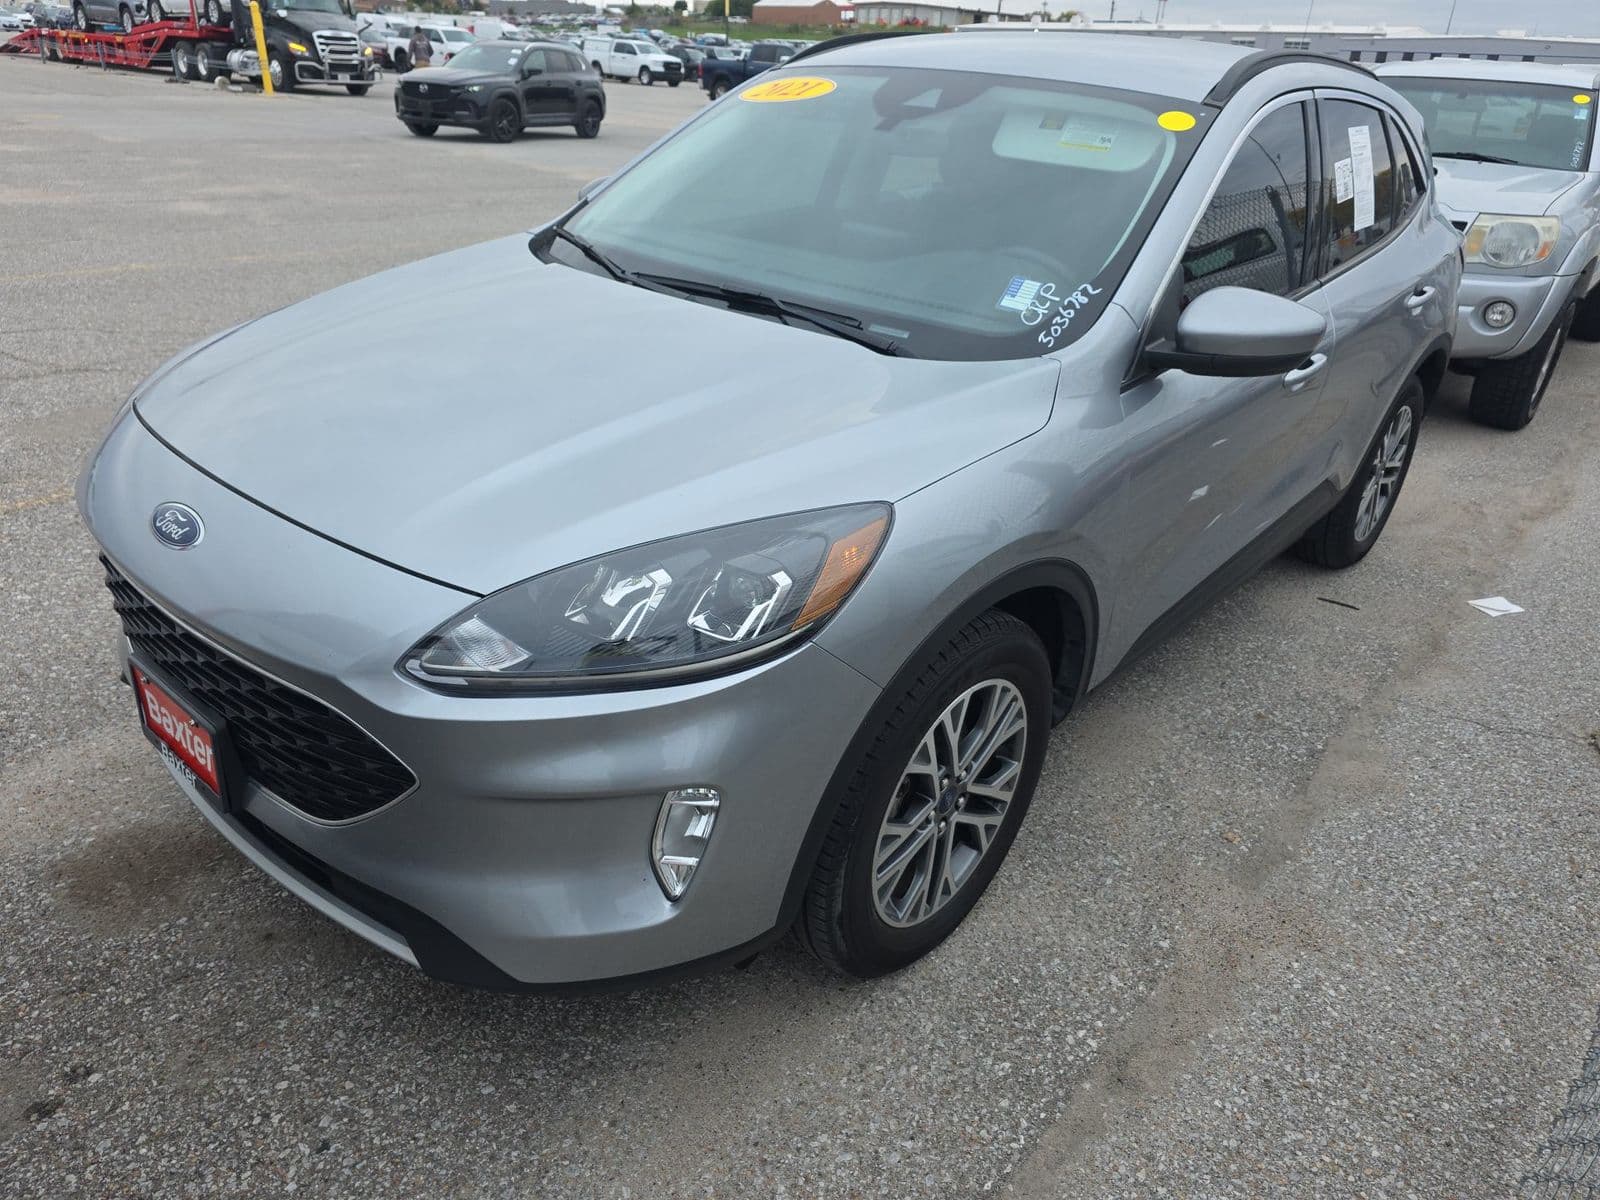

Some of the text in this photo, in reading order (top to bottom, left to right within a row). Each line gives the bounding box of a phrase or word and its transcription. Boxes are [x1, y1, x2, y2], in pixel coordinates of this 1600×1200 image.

[156, 510, 190, 540] Ford
[144, 689, 214, 772] Baxter
[160, 742, 198, 790] Baxter
